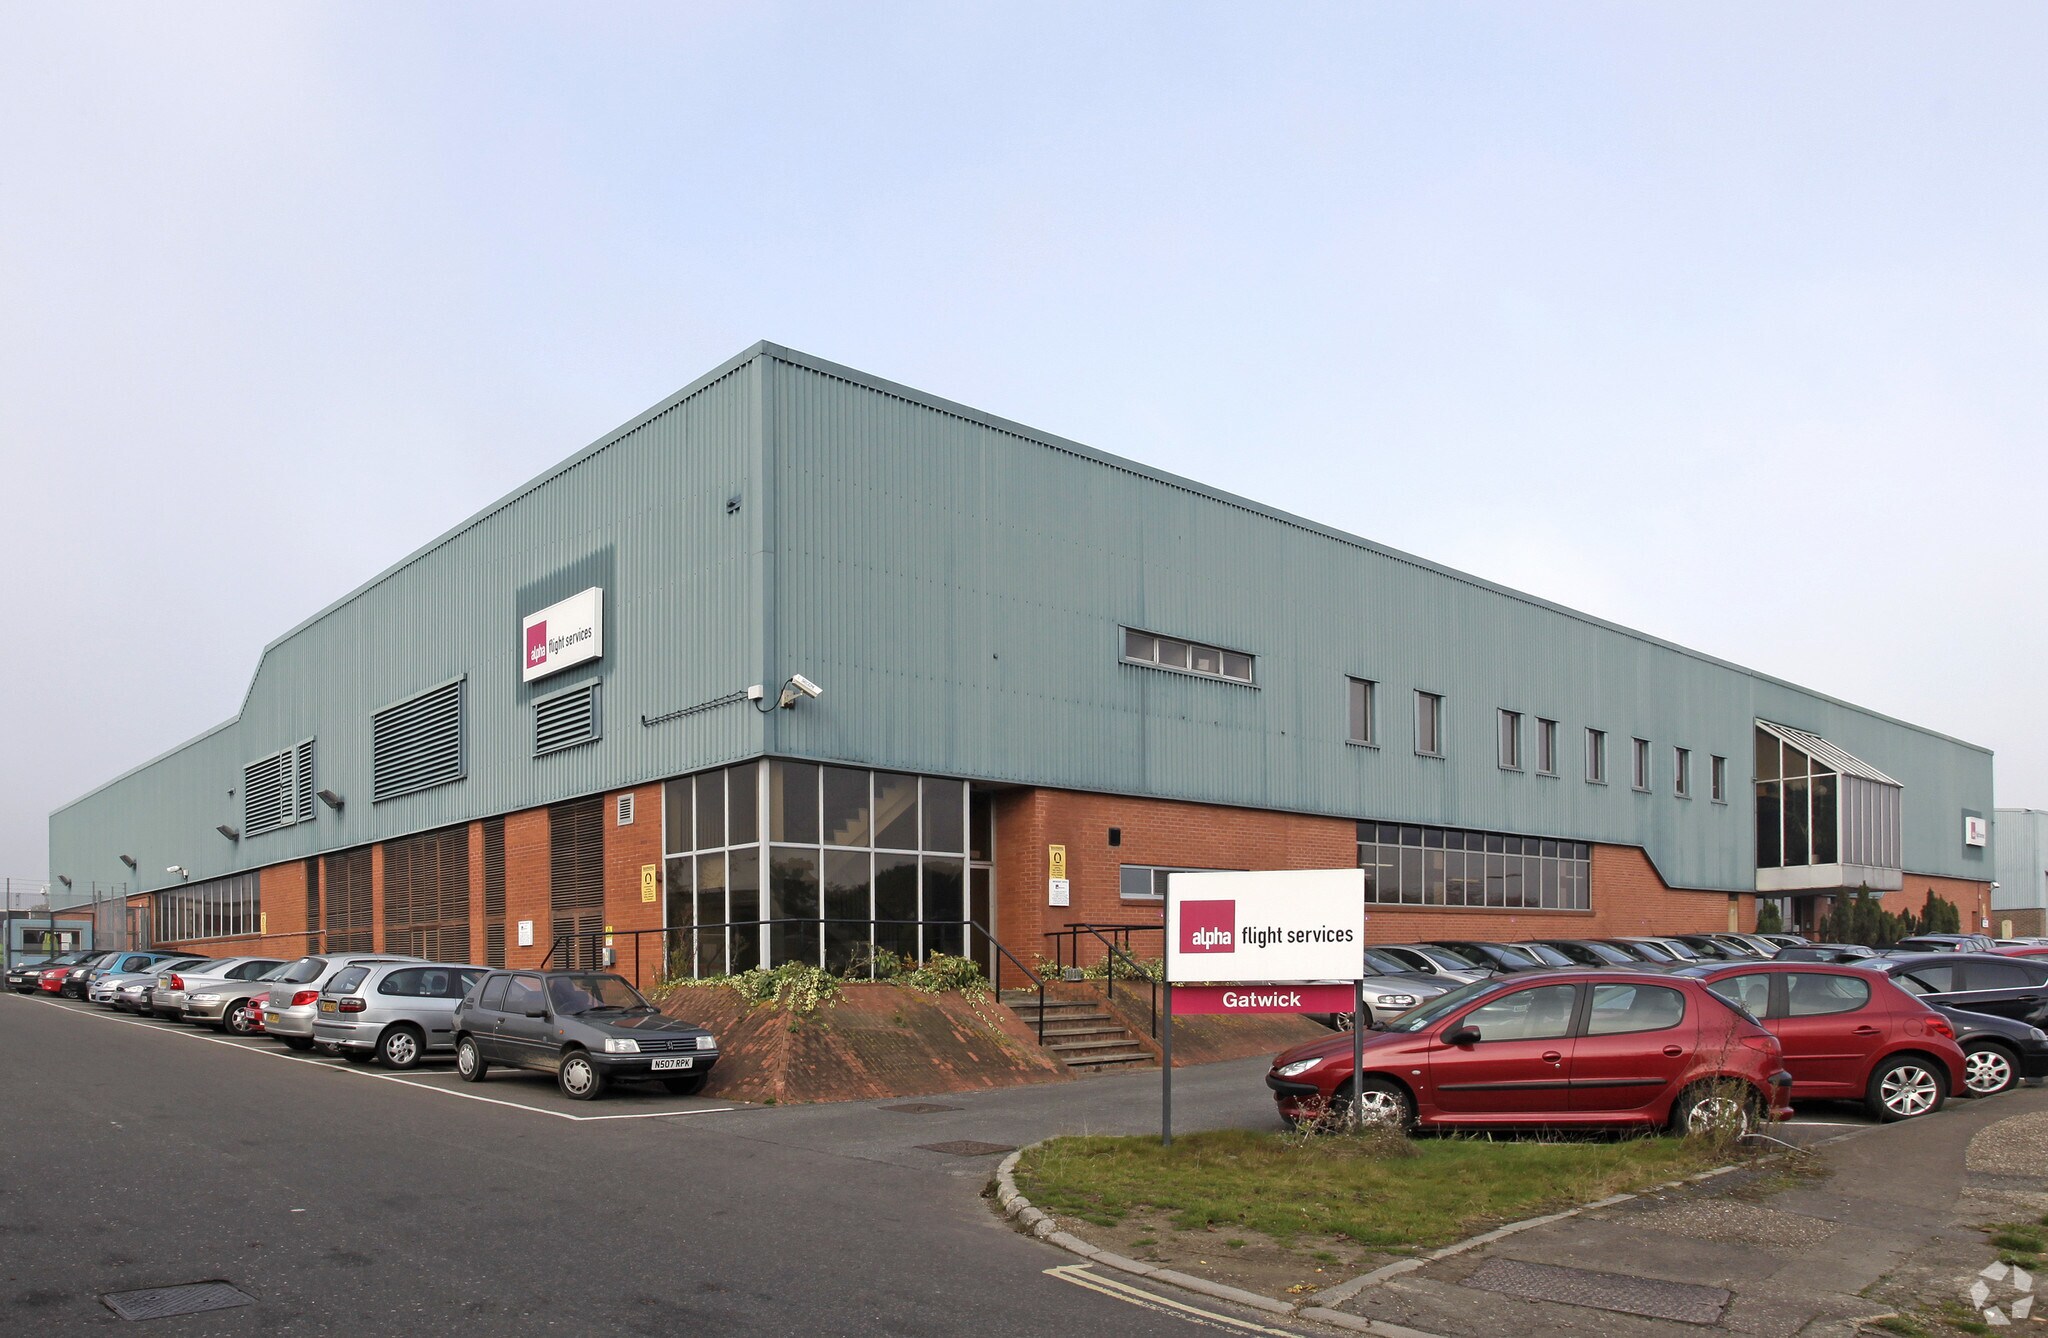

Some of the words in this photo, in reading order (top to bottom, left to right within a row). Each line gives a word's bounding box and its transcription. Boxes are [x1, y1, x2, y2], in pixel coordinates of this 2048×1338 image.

[531, 643, 546, 662] alpha
[548, 636, 565, 655] flight
[565, 627, 592, 647] services
[1192, 927, 1232, 950] alpha
[1242, 926, 1283, 949] flight
[1287, 925, 1354, 943] services
[1222, 991, 1302, 1008] Gatwick
[654, 1060, 675, 1069] N507
[675, 1059, 690, 1067] RPK
